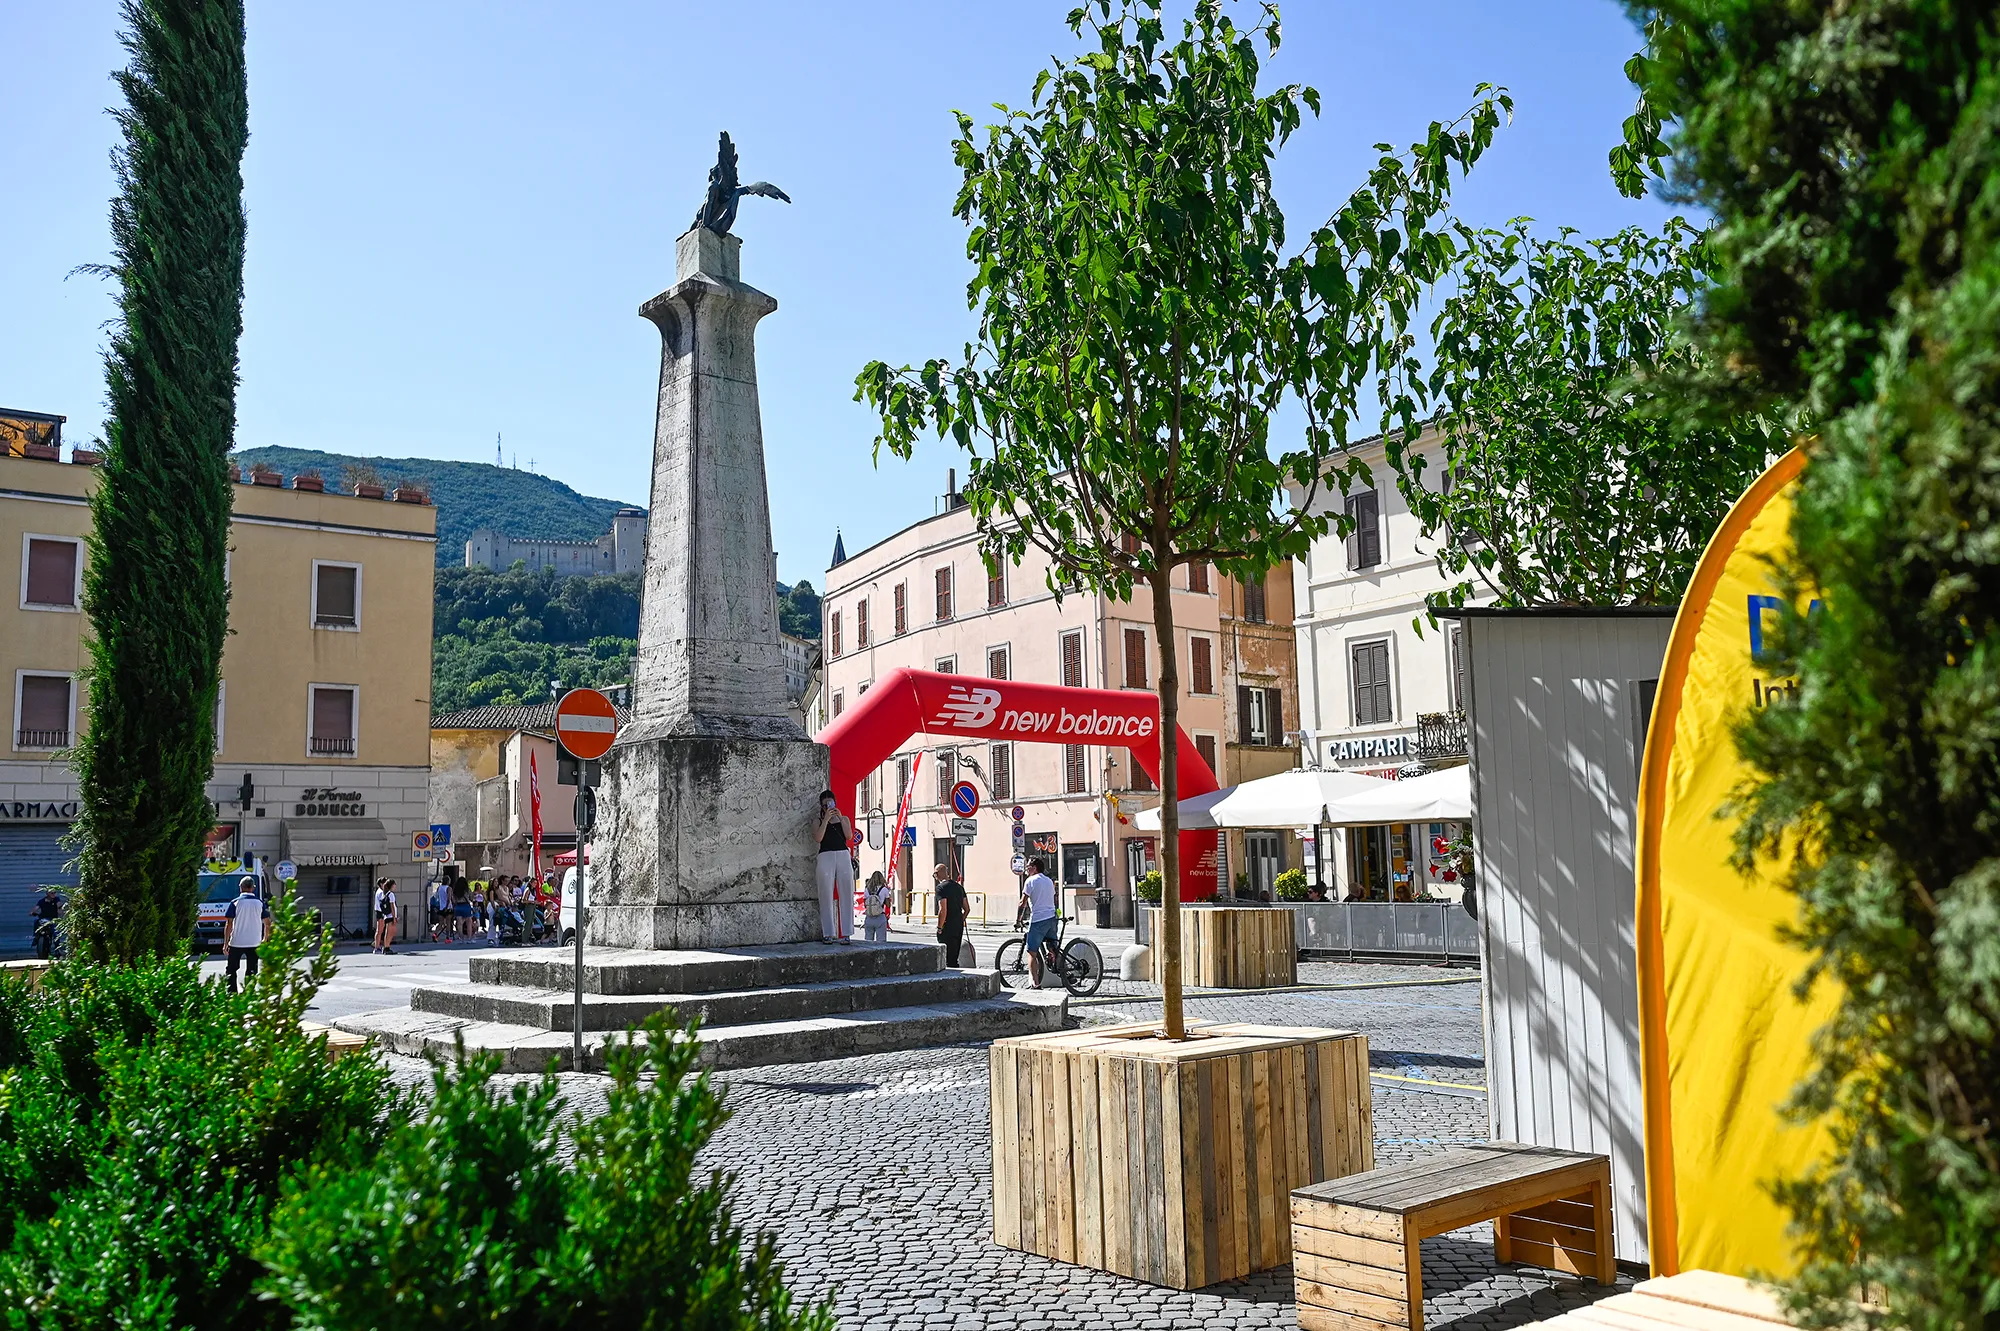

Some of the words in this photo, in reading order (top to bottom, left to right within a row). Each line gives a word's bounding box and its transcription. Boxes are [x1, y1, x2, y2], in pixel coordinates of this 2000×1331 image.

[999, 709, 1055, 733] new
[1056, 707, 1154, 737] balance
[1328, 737, 1406, 760] CAMPARI
[318, 787, 362, 801] Fornaio
[0, 802, 78, 818] ARMACI
[295, 803, 366, 816] BONUCCI
[314, 855, 366, 864] CAFFETTERIA
